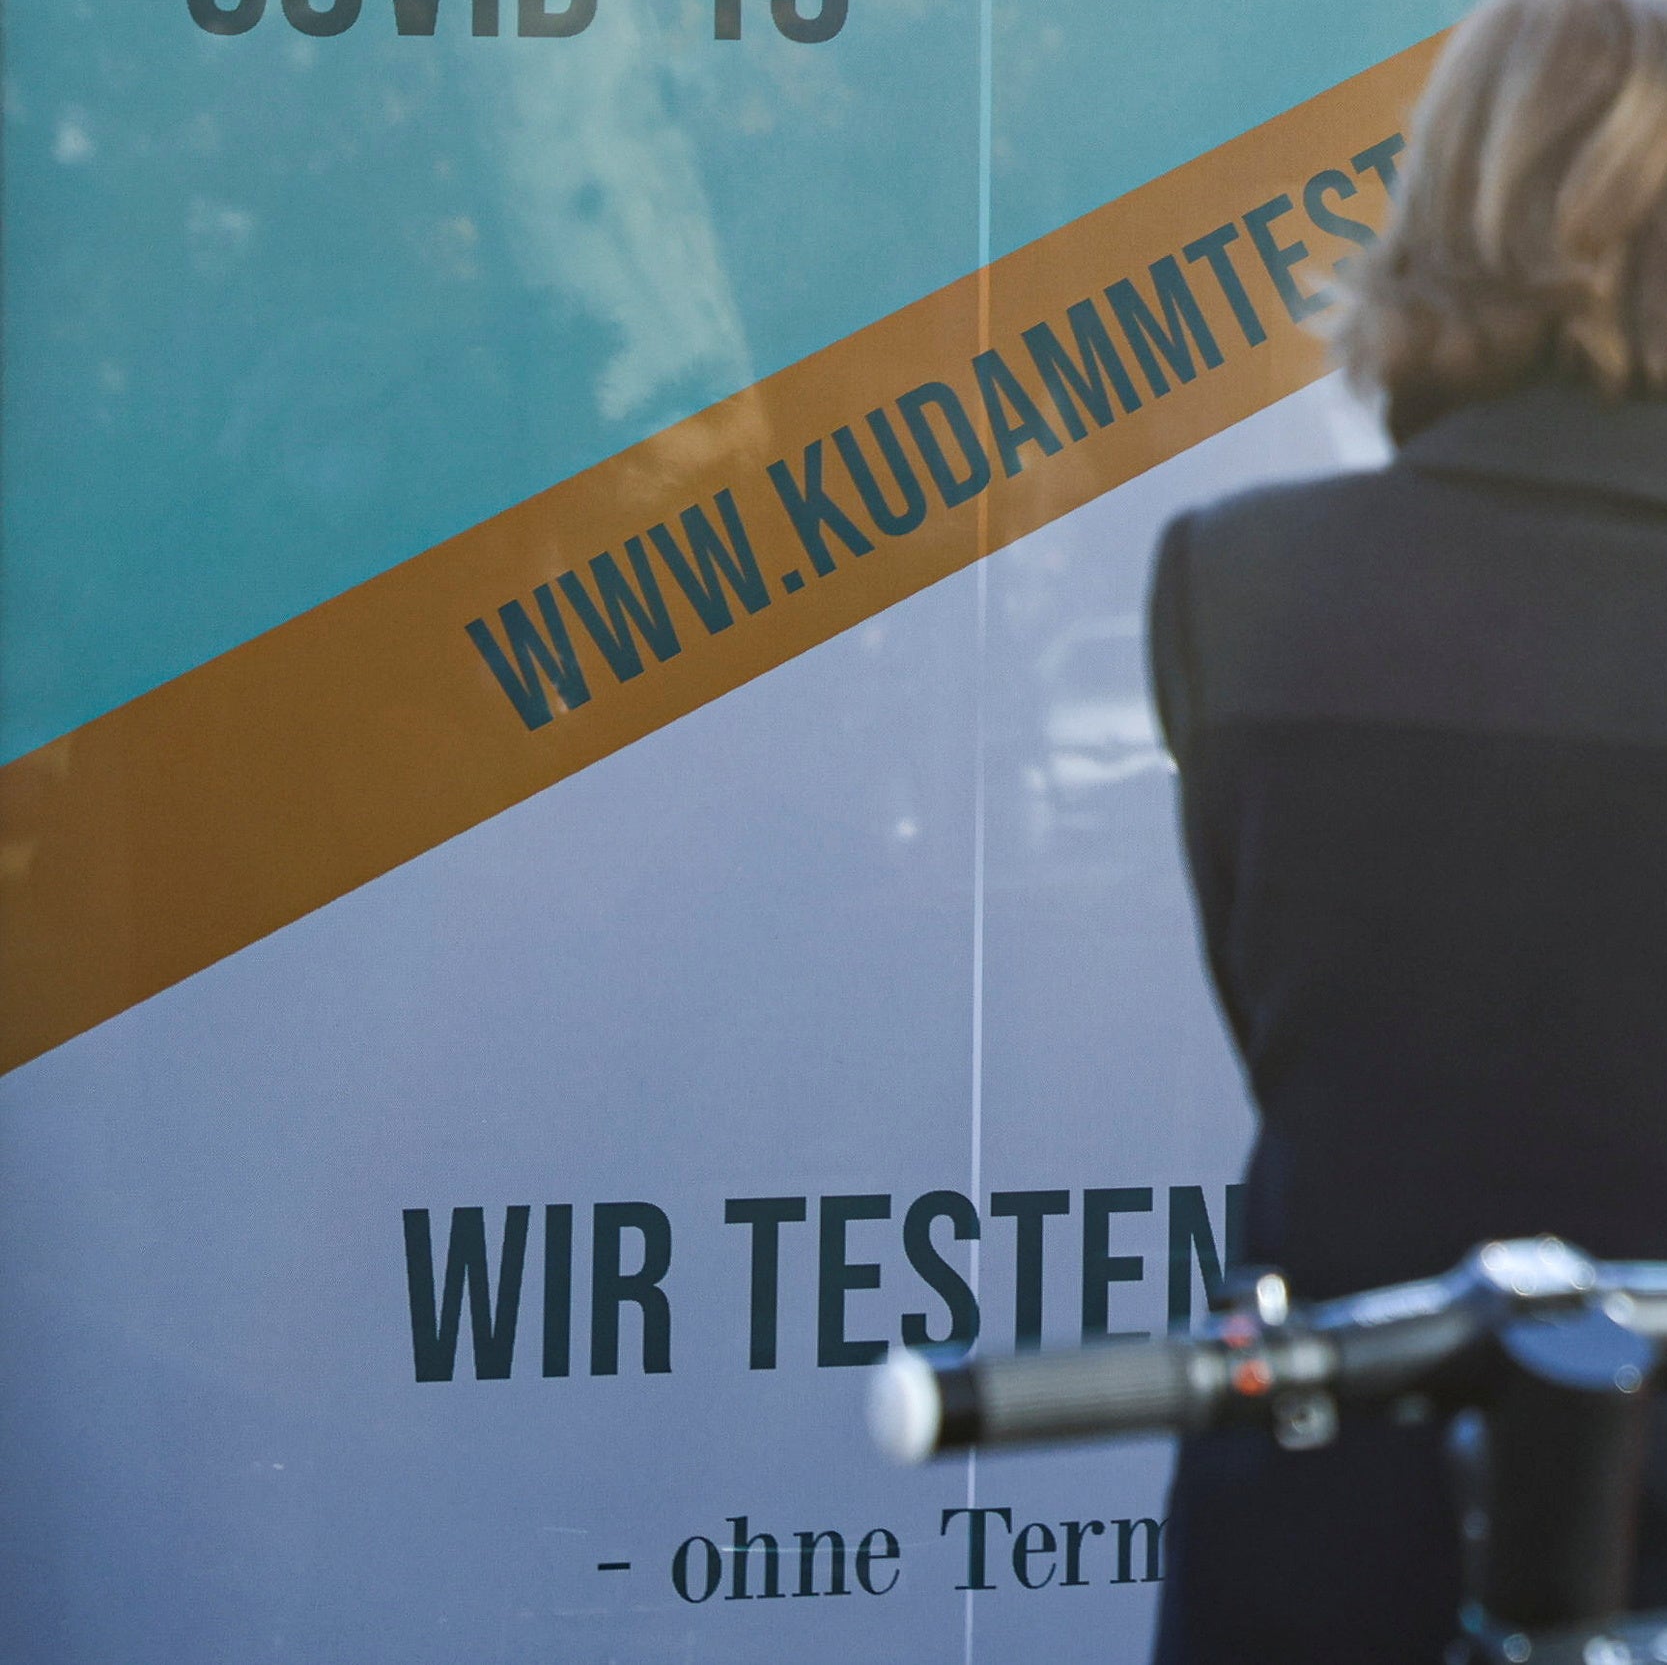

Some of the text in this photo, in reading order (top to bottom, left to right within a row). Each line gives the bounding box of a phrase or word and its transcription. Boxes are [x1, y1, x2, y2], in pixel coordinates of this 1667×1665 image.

[402, 1184, 1248, 1383] WIR TESTEN
[671, 1516, 901, 1604] ohne
[941, 1506, 1168, 1591] Term
